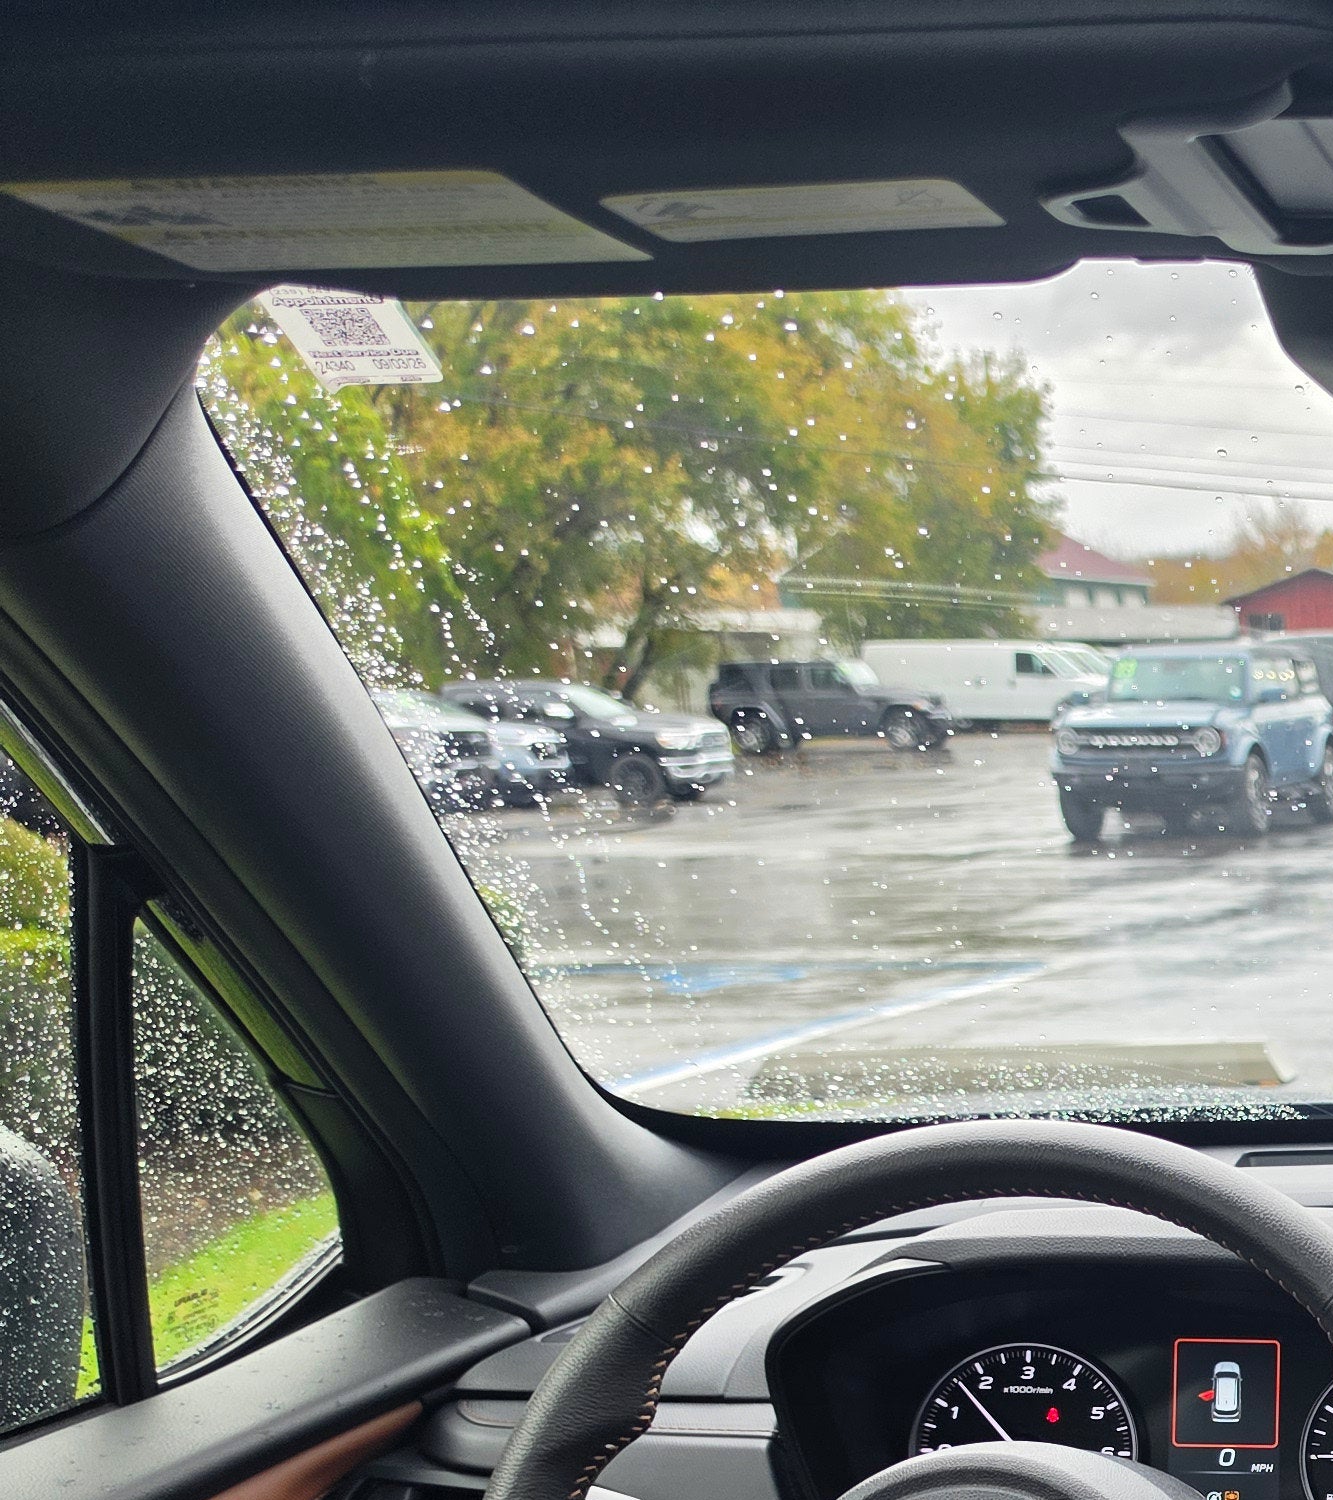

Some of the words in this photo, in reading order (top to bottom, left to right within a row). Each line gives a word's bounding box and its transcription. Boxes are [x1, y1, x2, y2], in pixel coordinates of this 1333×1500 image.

[272, 295, 384, 307] Appointments
[1020, 1366, 1035, 1380] 3
[978, 1376, 994, 1390] 2
[1062, 1377, 1077, 1391] 4
[950, 1406, 959, 1420] 1
[1090, 1406, 1105, 1420] 5
[1218, 1448, 1236, 1467] 0
[1250, 1463, 1274, 1473] MPH
